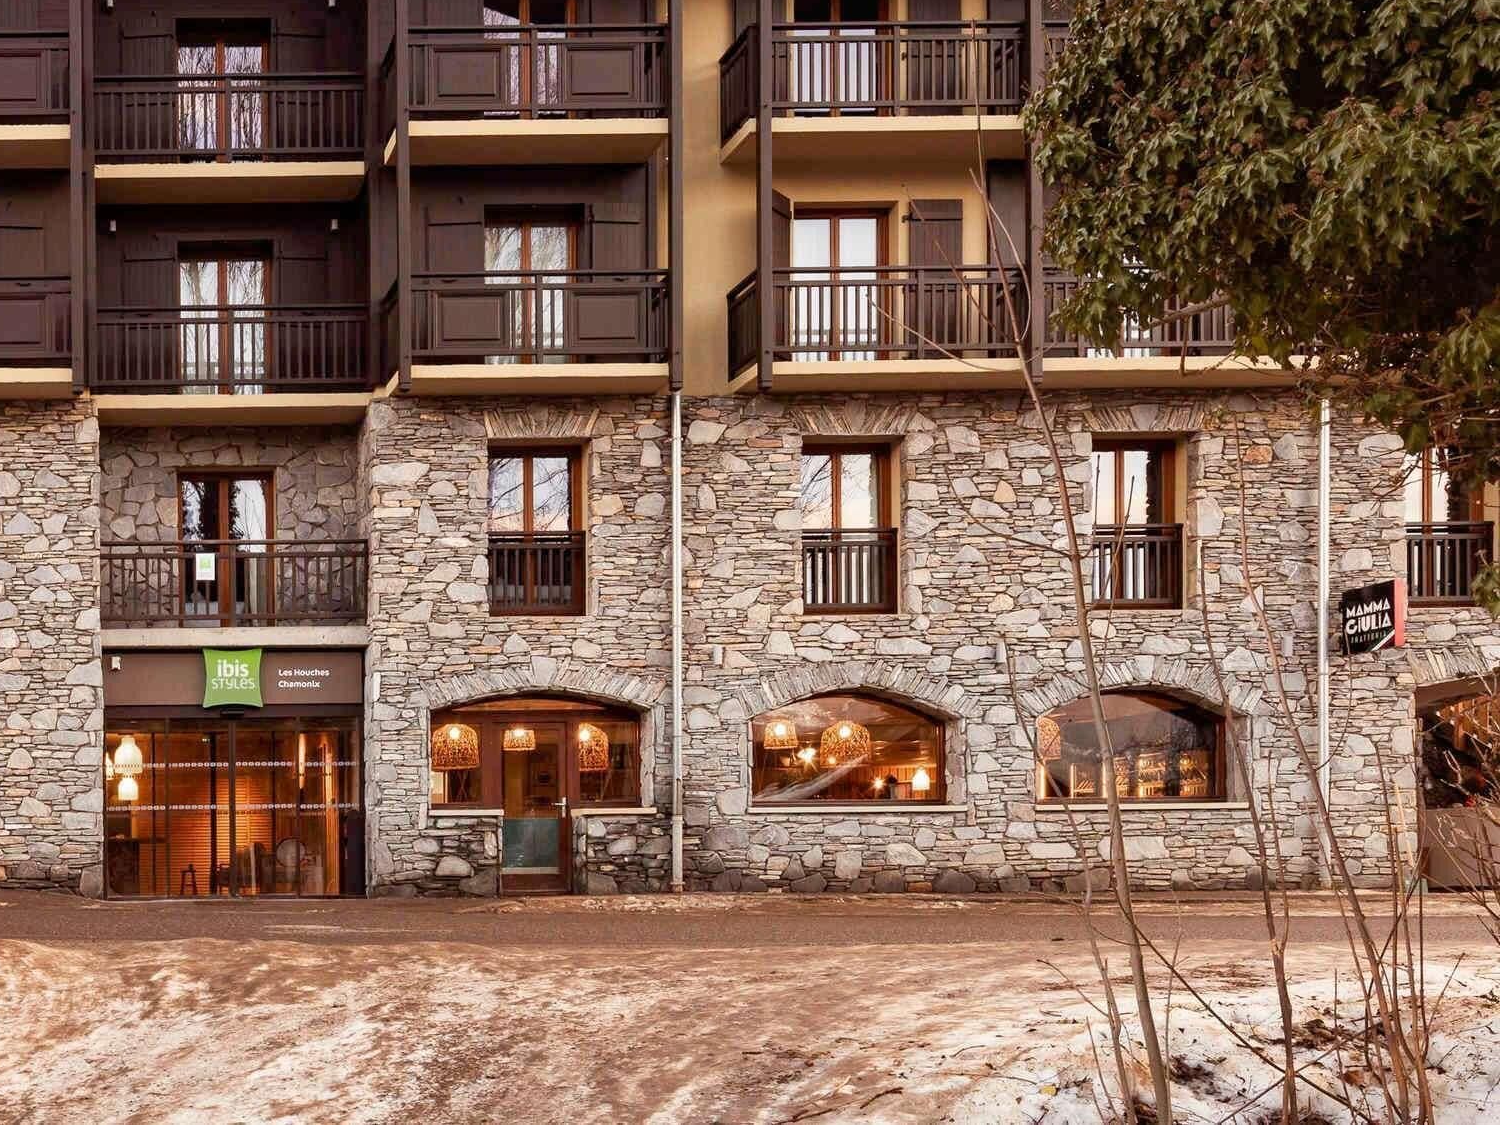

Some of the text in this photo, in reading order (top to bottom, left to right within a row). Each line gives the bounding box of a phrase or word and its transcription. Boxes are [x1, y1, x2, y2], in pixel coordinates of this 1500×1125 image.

[1346, 597, 1391, 619] MAMMA
[217, 659, 249, 677] ibis
[278, 669, 330, 677] Les Houches
[278, 680, 320, 688] Chamonix
